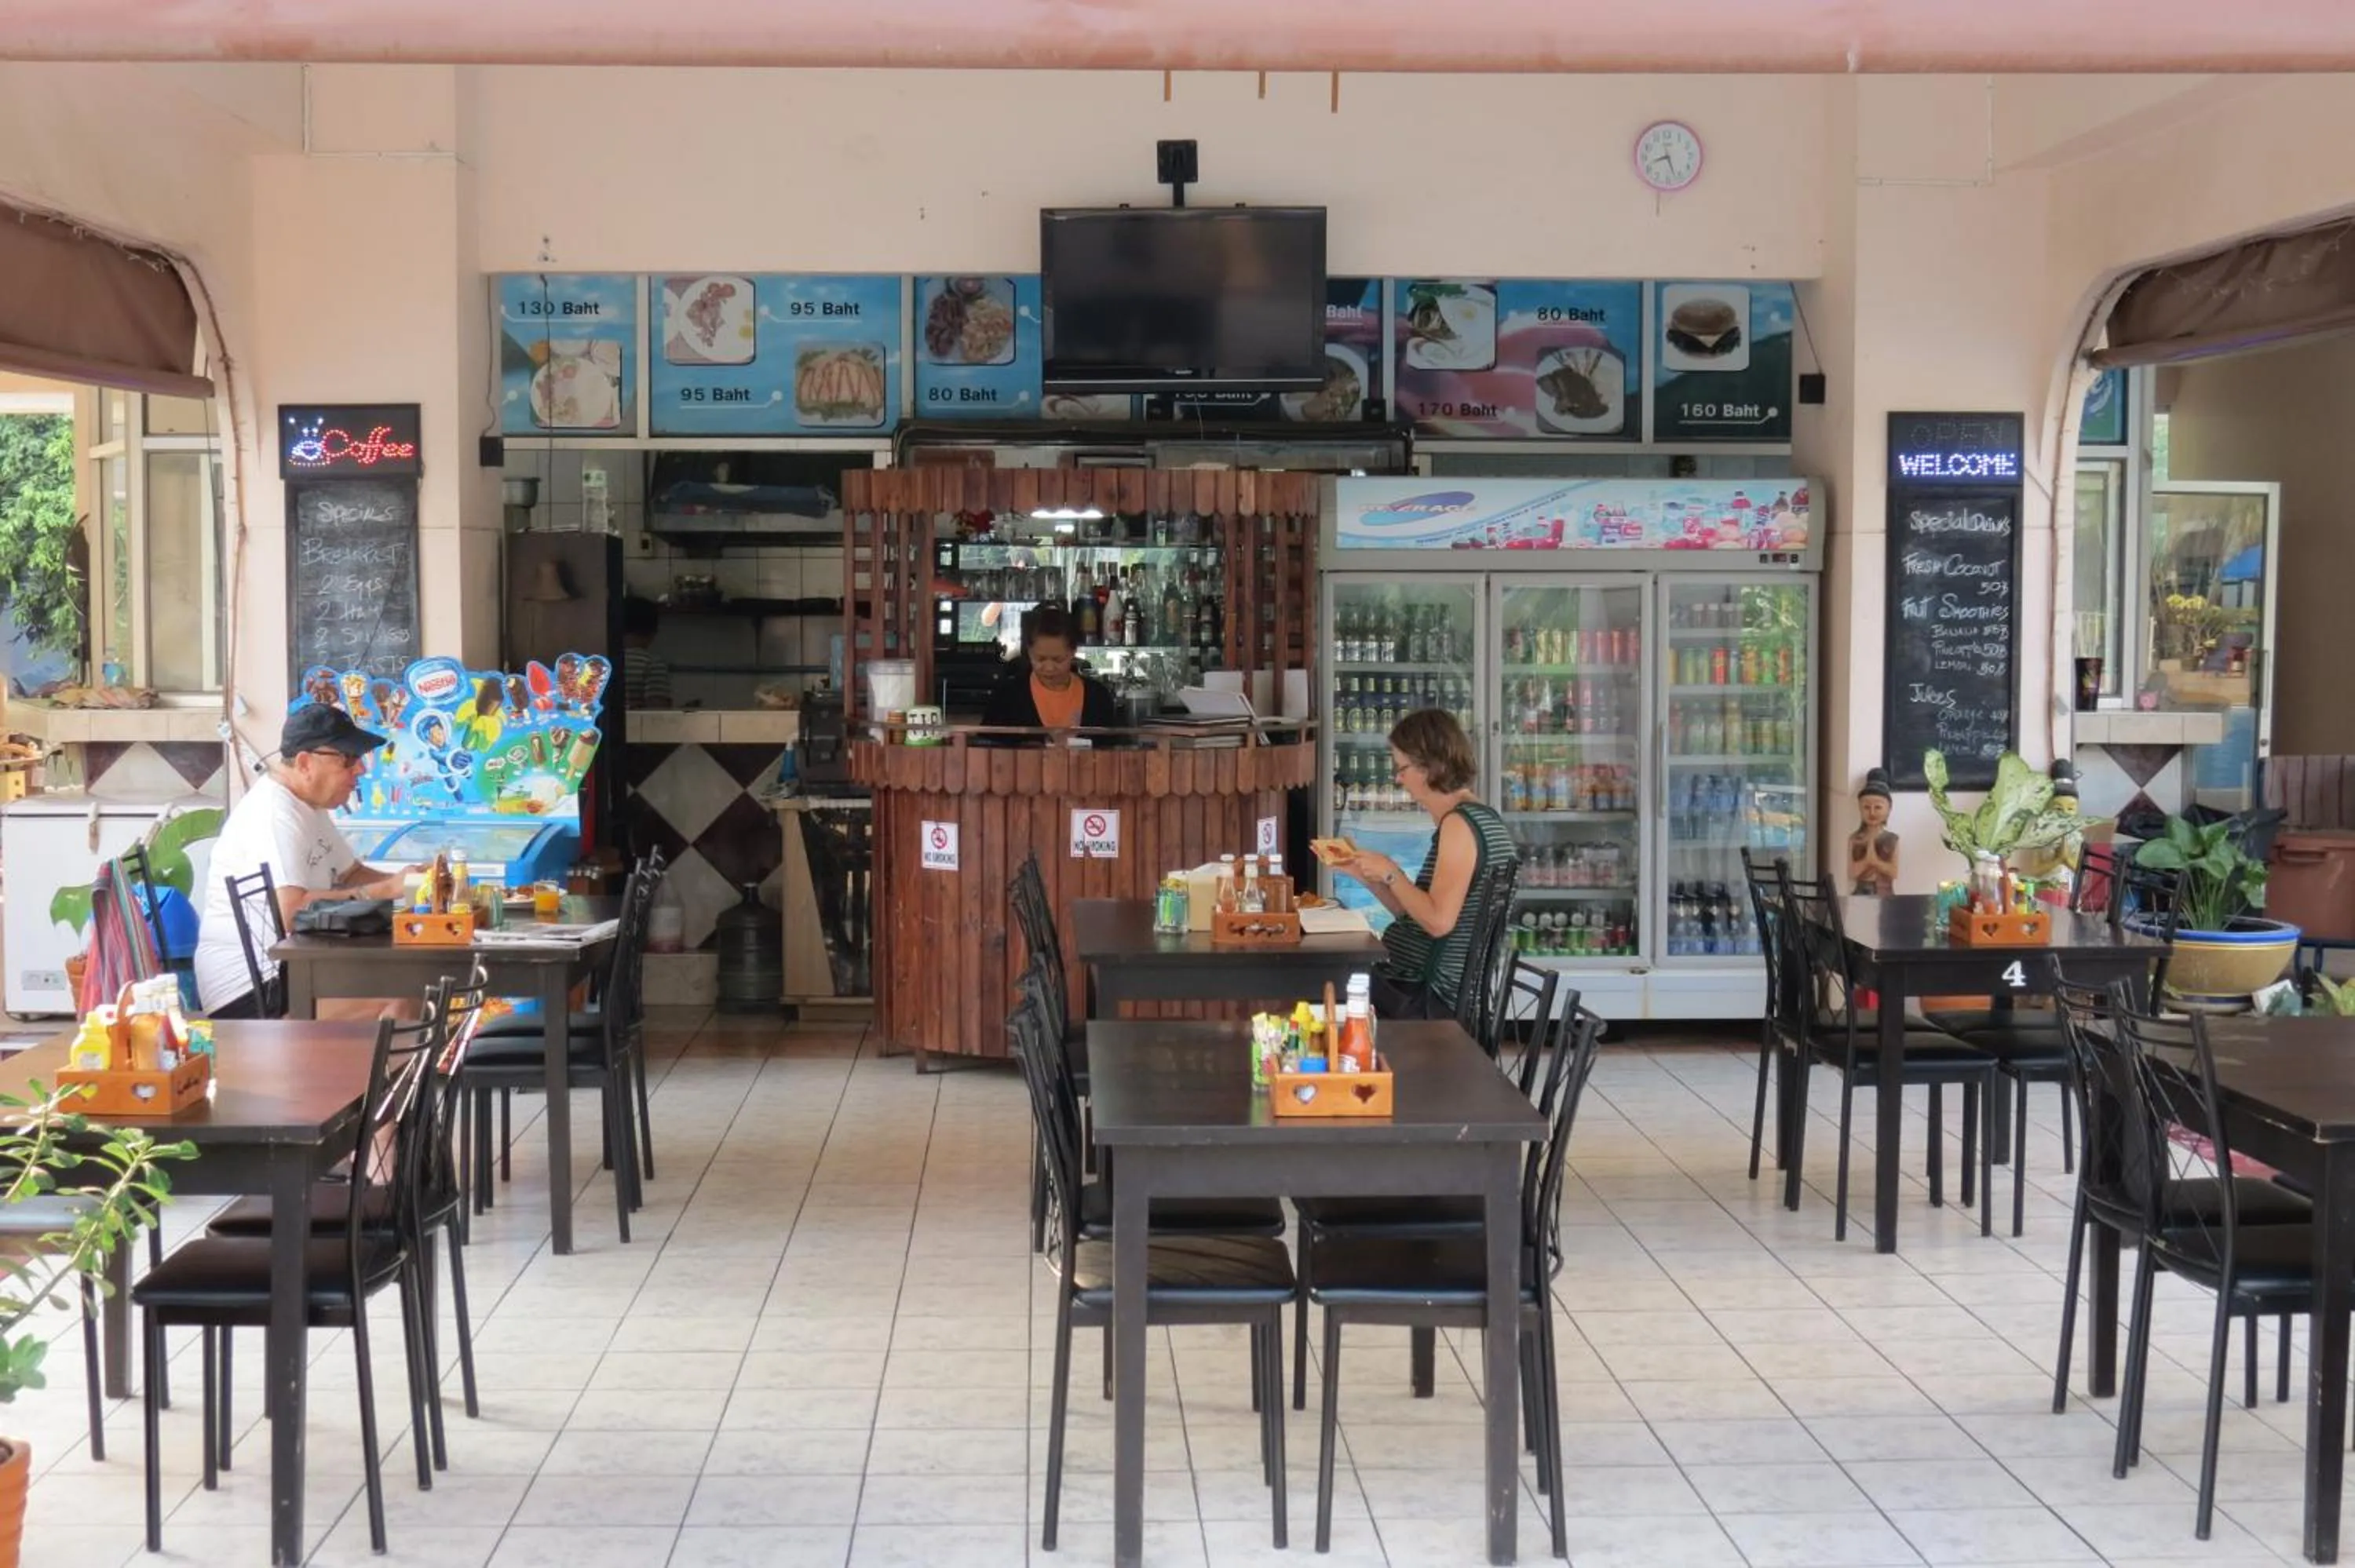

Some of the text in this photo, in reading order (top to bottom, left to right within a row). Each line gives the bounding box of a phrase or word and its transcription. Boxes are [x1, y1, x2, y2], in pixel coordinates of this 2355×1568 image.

[518, 301, 600, 315] 130 Baht
[790, 301, 860, 315] 95 Baht
[1326, 304, 1362, 319] Baht
[1537, 306, 1605, 322] 80 Baht
[681, 388, 750, 401] 95 Baht
[929, 387, 997, 402] 80 Baht
[1418, 402, 1497, 417] 170 Baht
[1681, 403, 1759, 418] 160 Baht
[1898, 453, 2017, 476] WELCOME
[2002, 961, 2026, 986] 4
